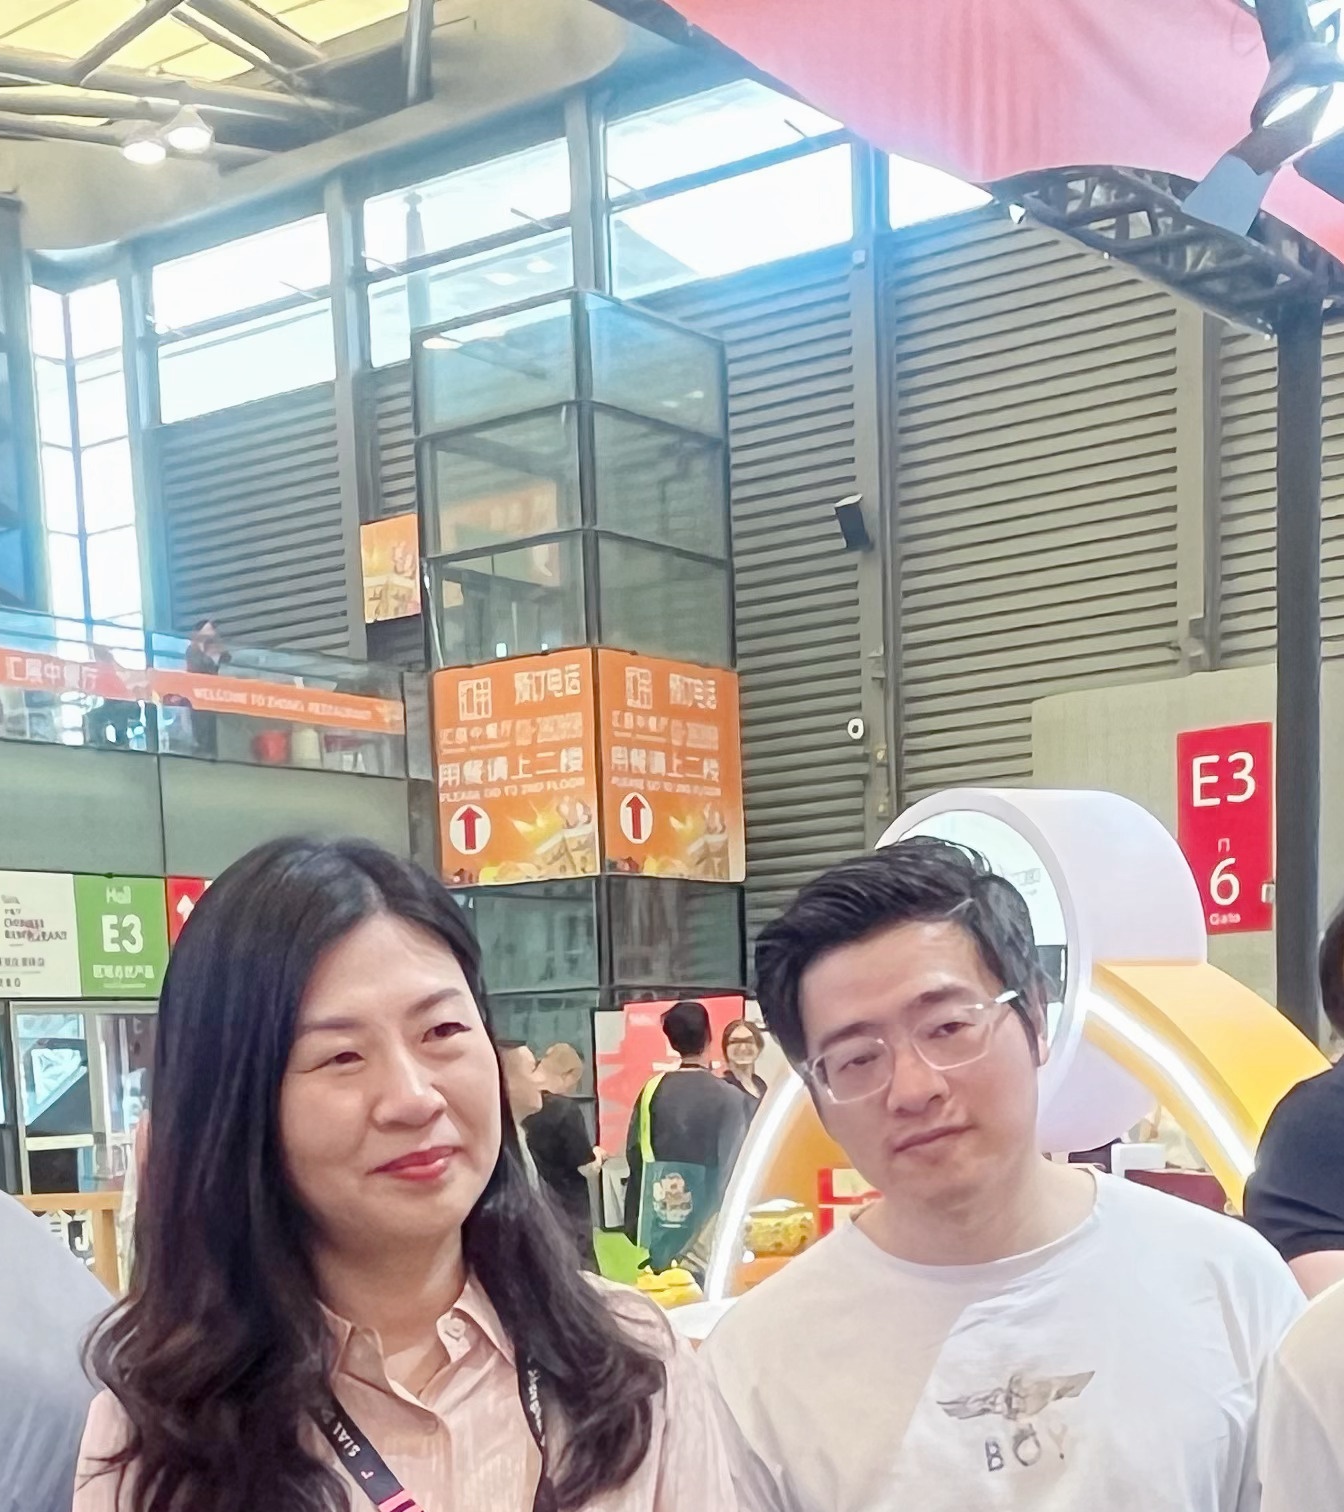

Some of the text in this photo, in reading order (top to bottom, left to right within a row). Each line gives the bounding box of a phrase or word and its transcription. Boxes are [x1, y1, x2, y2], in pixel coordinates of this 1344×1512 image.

[1192, 751, 1256, 807] E3
[1209, 857, 1240, 906] 6
[101, 914, 143, 954] E3
[333, 1421, 361, 1457] SIAL
